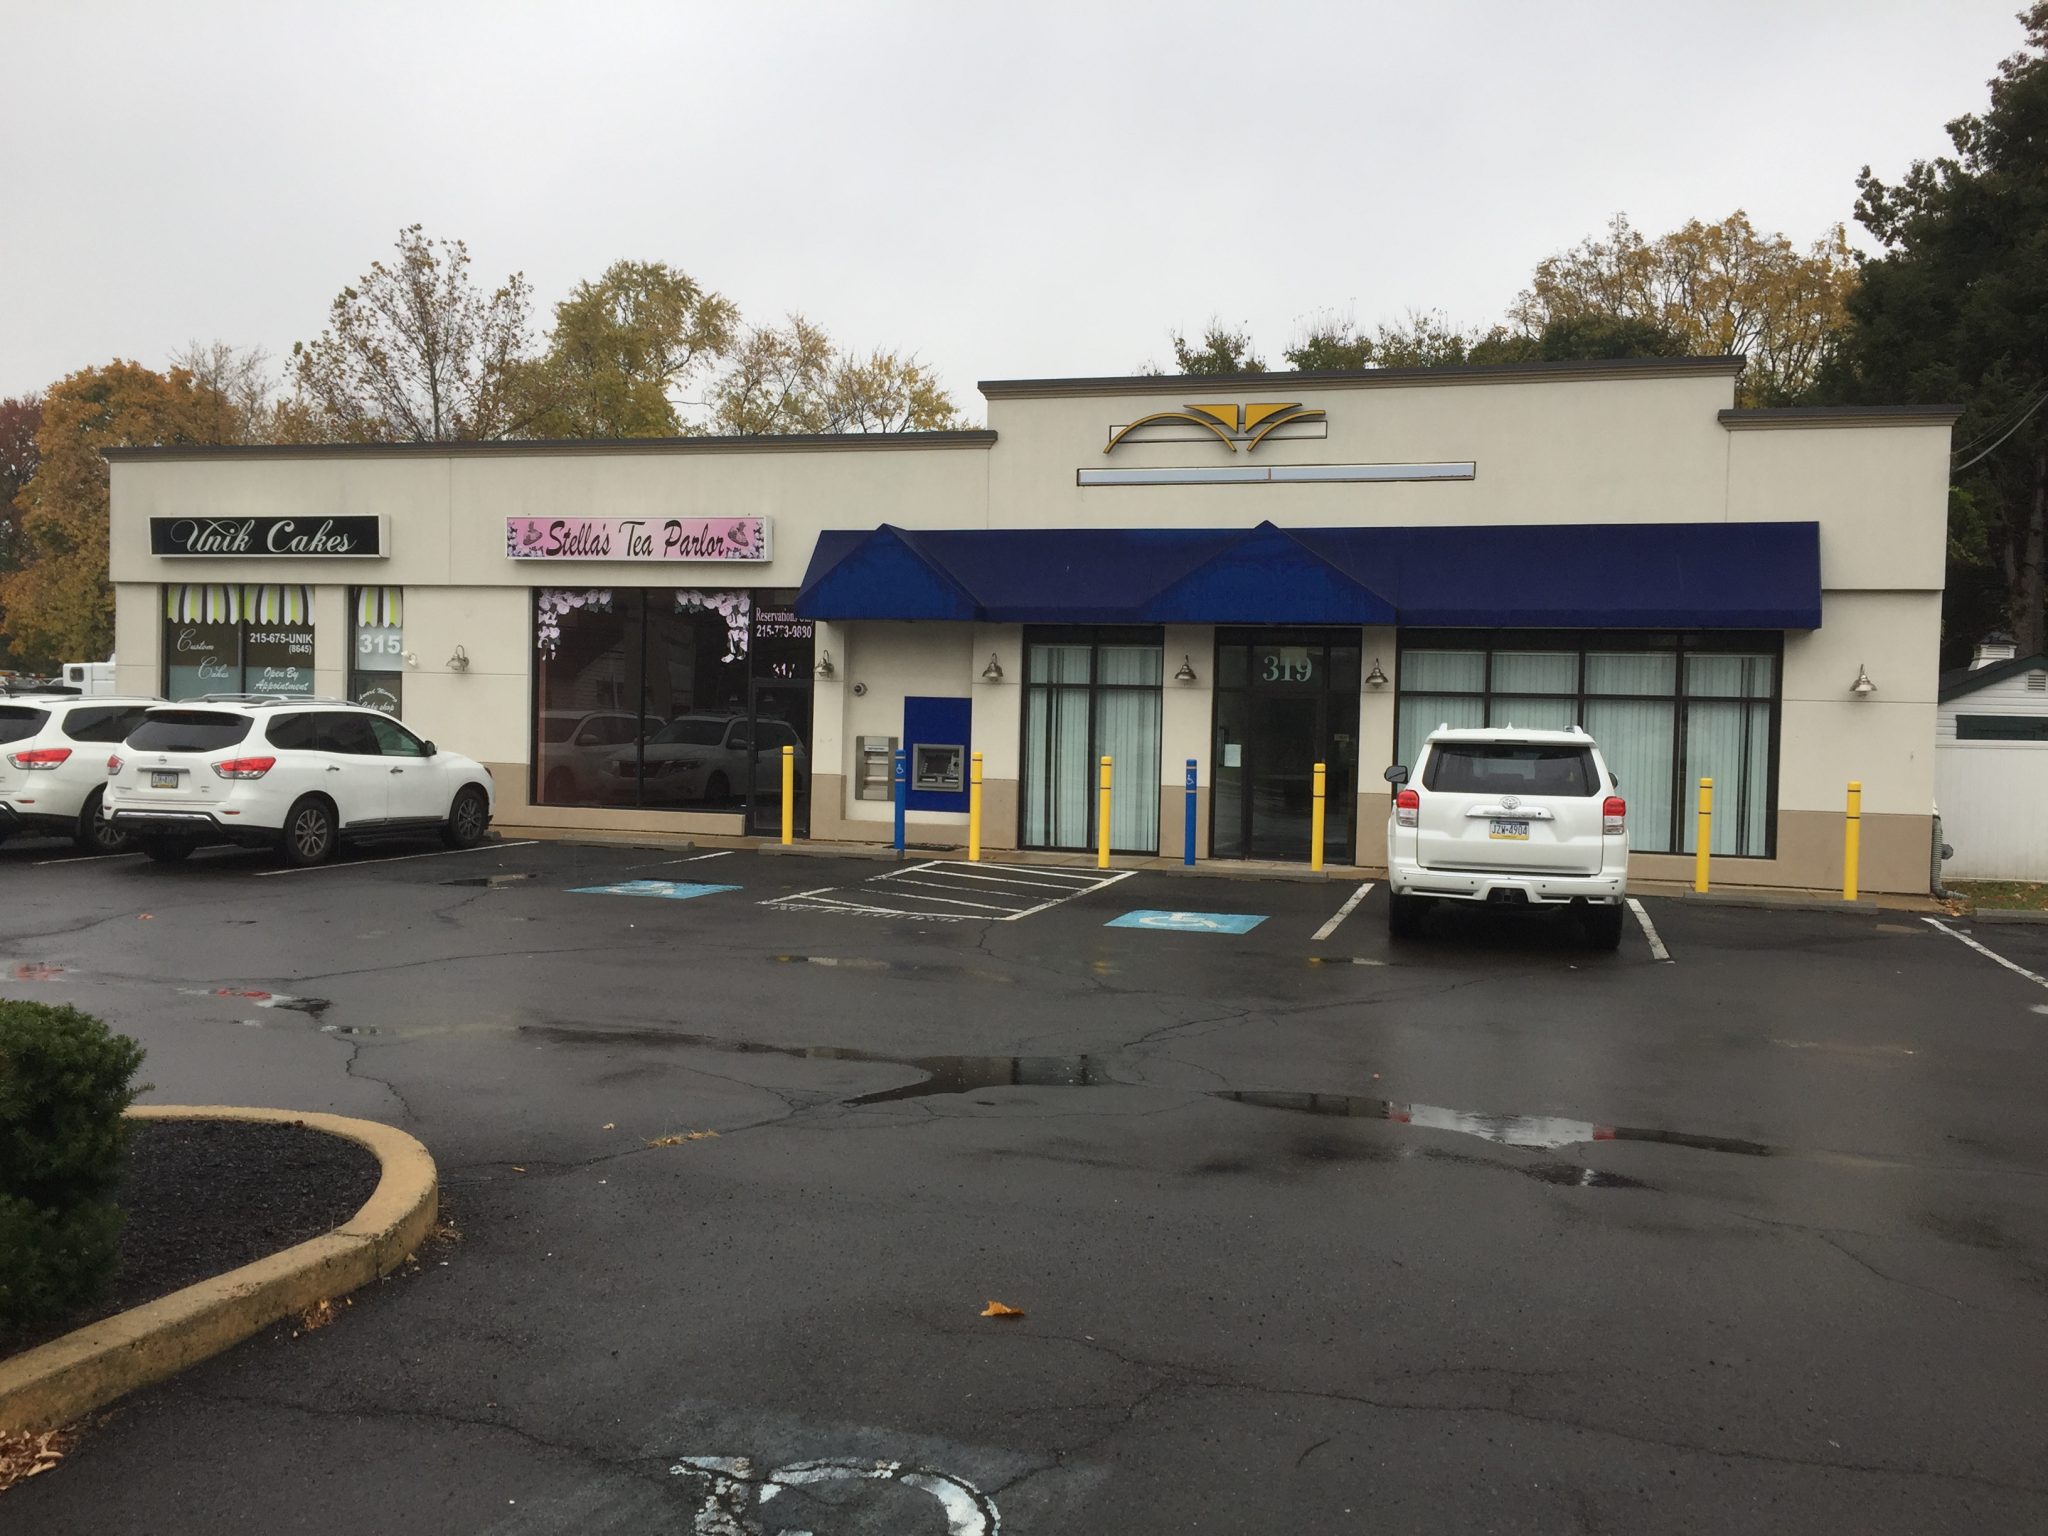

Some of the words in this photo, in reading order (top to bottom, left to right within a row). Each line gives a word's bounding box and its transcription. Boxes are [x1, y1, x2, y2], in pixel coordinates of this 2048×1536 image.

[170, 519, 256, 553] Unik
[266, 519, 358, 553] Cakes
[546, 520, 612, 557] Stella's
[618, 520, 654, 557] Tea
[663, 519, 725, 558] Parlor
[177, 627, 215, 652] Custom
[249, 632, 314, 645] 215-675-UNIK
[288, 644, 312, 655] (8645)
[359, 633, 401, 654] 315
[198, 656, 230, 680] Cakes
[263, 666, 285, 680] Open
[286, 666, 300, 681] By
[1262, 655, 1313, 682] 319
[253, 679, 310, 692] Appointment
